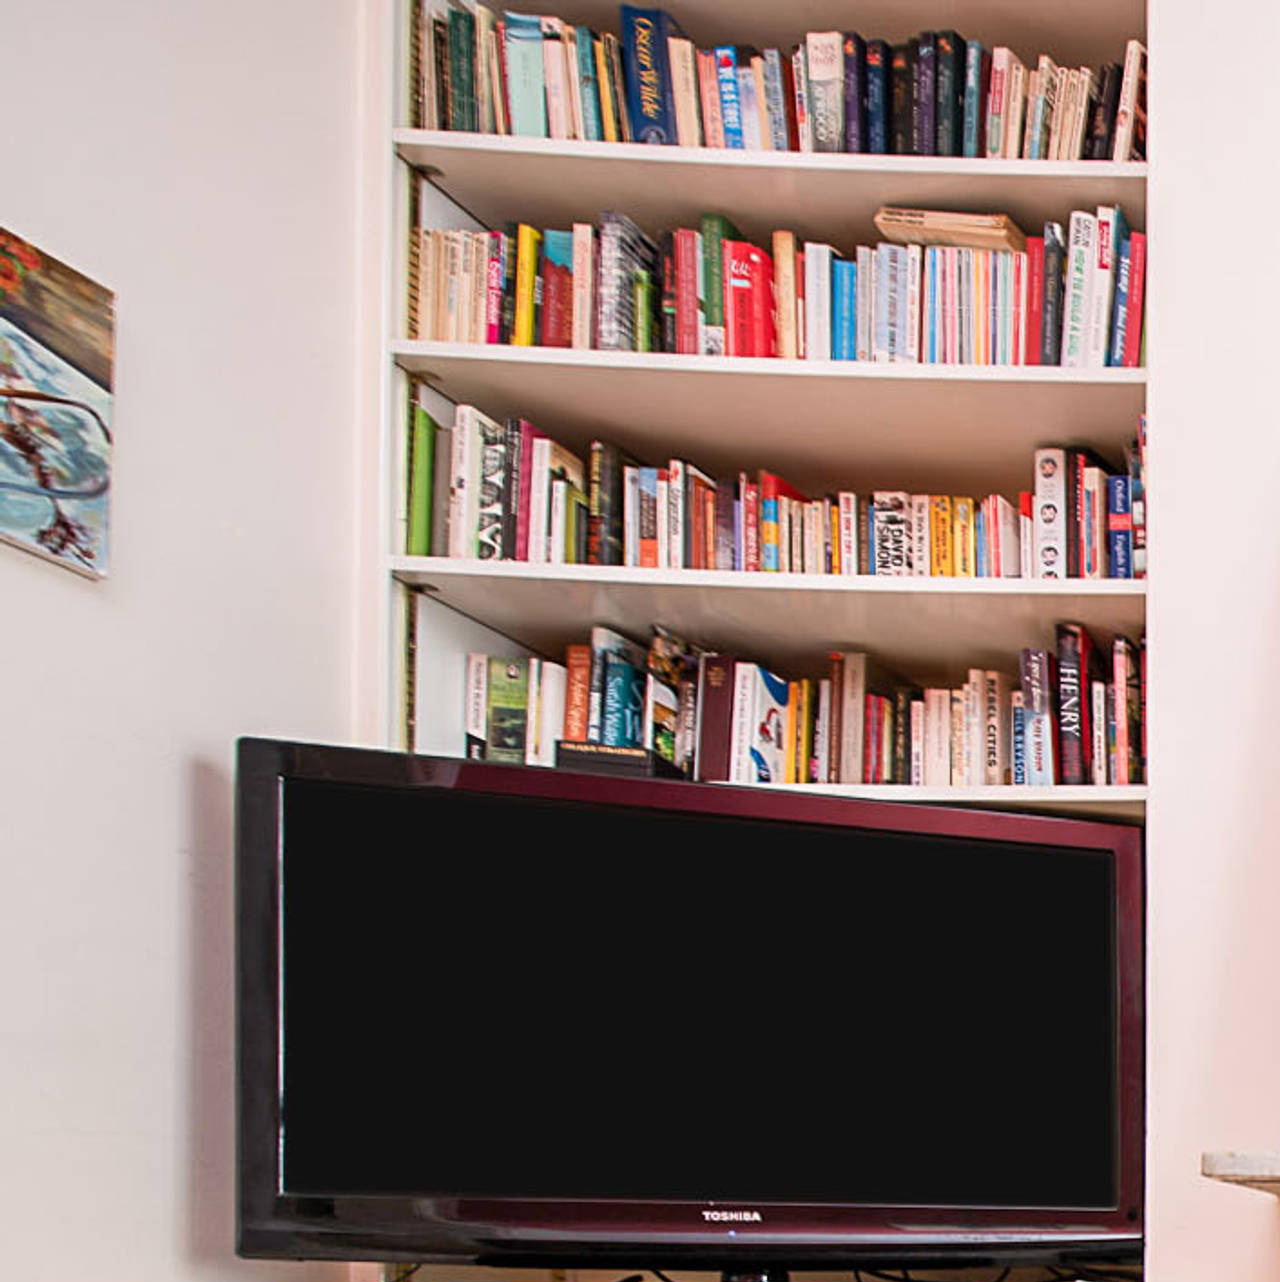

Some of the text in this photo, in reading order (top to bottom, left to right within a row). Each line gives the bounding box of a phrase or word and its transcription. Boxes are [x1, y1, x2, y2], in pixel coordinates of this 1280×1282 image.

[633, 16, 661, 120] Oscar Wilde
[877, 525, 891, 569] SIMON
[890, 528, 905, 567] DAVID
[986, 678, 998, 768] REBEL CITIES
[1060, 667, 1081, 737] HENRY
[702, 1210, 762, 1222] TOSHIBA
